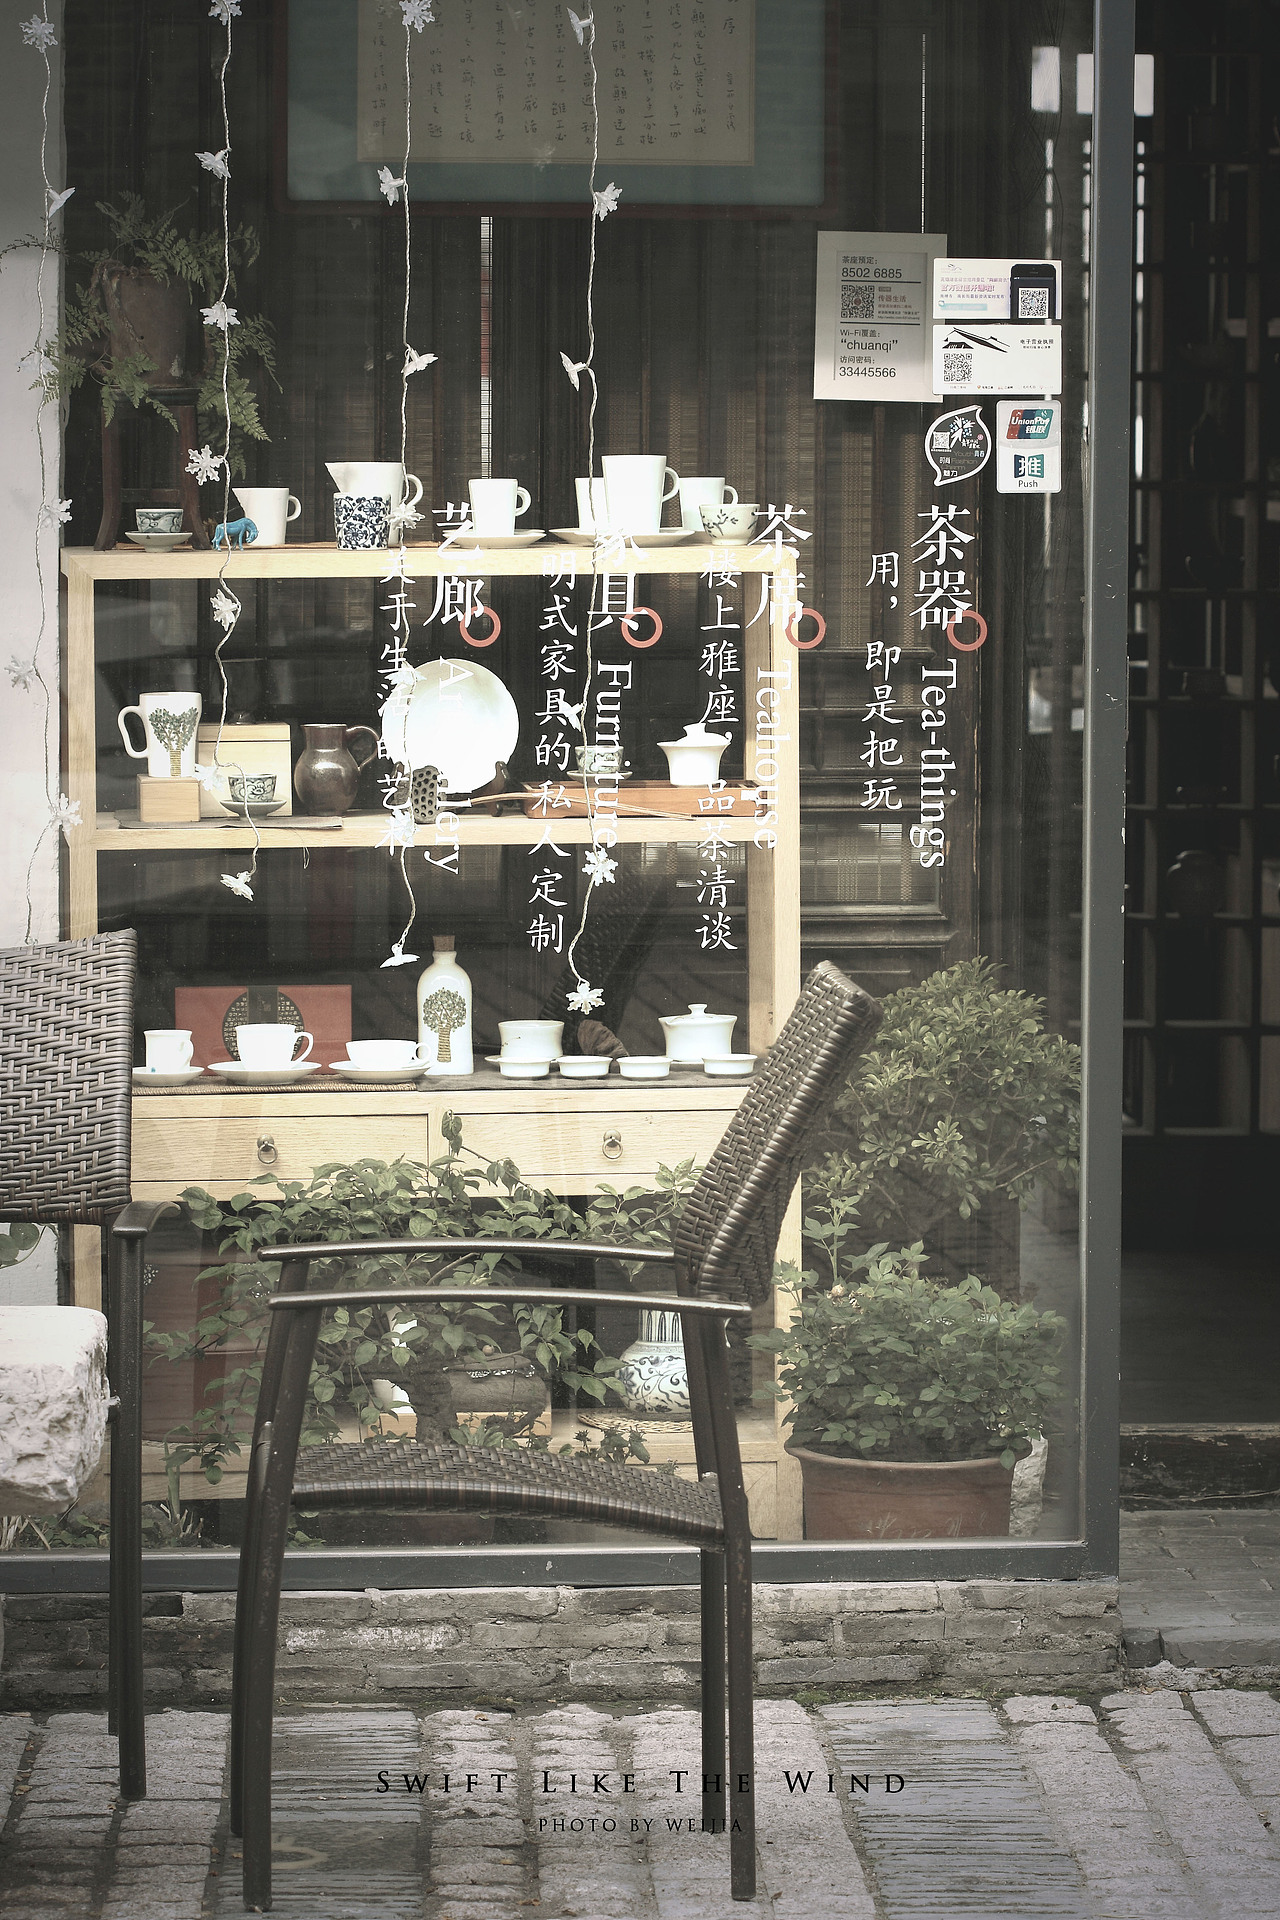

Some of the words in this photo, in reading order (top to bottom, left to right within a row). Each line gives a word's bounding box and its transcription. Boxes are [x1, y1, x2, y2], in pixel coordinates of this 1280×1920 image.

[841, 267, 870, 278] 8502
[873, 268, 902, 279] 6885
[839, 366, 896, 378] 33445566
[1011, 416, 1050, 428] UnionPay
[1018, 457, 1042, 476] 推
[1018, 480, 1038, 488] Push
[422, 501, 486, 630] 艺廊
[746, 503, 813, 631] 茶席
[910, 503, 975, 631] 茶器
[526, 552, 578, 954] 明式家具的私人定制
[593, 659, 633, 849] Furniture
[754, 658, 793, 850] Teahouse
[909, 658, 958, 869] Tea-things
